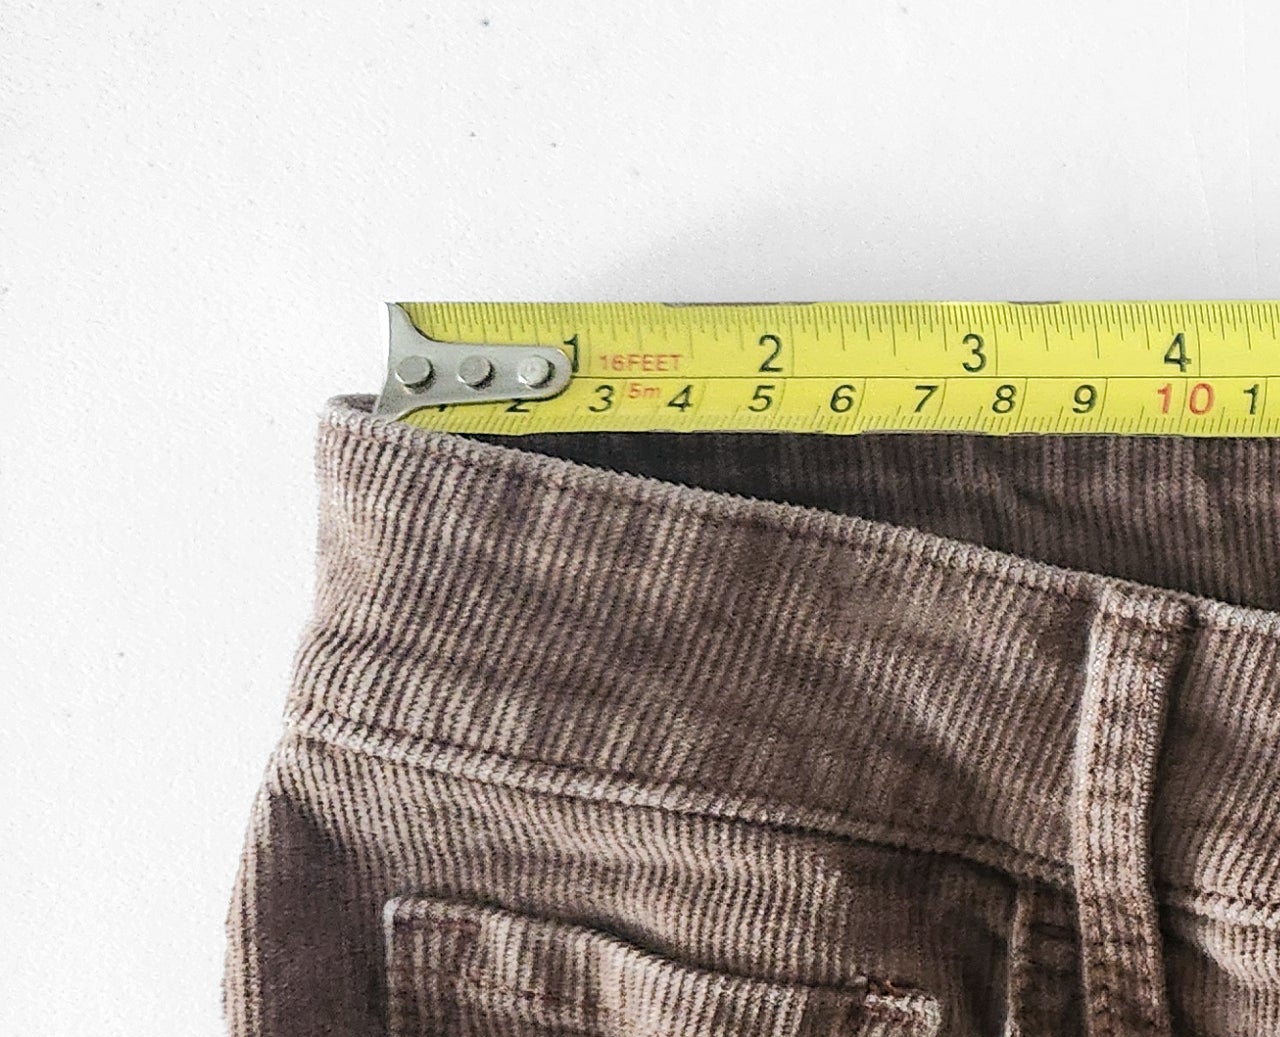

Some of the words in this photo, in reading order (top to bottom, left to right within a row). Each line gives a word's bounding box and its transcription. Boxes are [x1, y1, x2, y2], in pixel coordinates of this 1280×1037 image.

[757, 335, 783, 372] 2
[962, 333, 987, 372] 3
[1163, 332, 1192, 373] 4
[589, 385, 614, 412] 3
[629, 383, 660, 398] 5m
[667, 385, 693, 412] 4
[748, 385, 775, 412] 5
[830, 385, 856, 413] 6
[913, 385, 938, 413] 7
[991, 385, 1017, 415] 8
[1072, 385, 1097, 414] 9
[1244, 383, 1260, 415] 1
